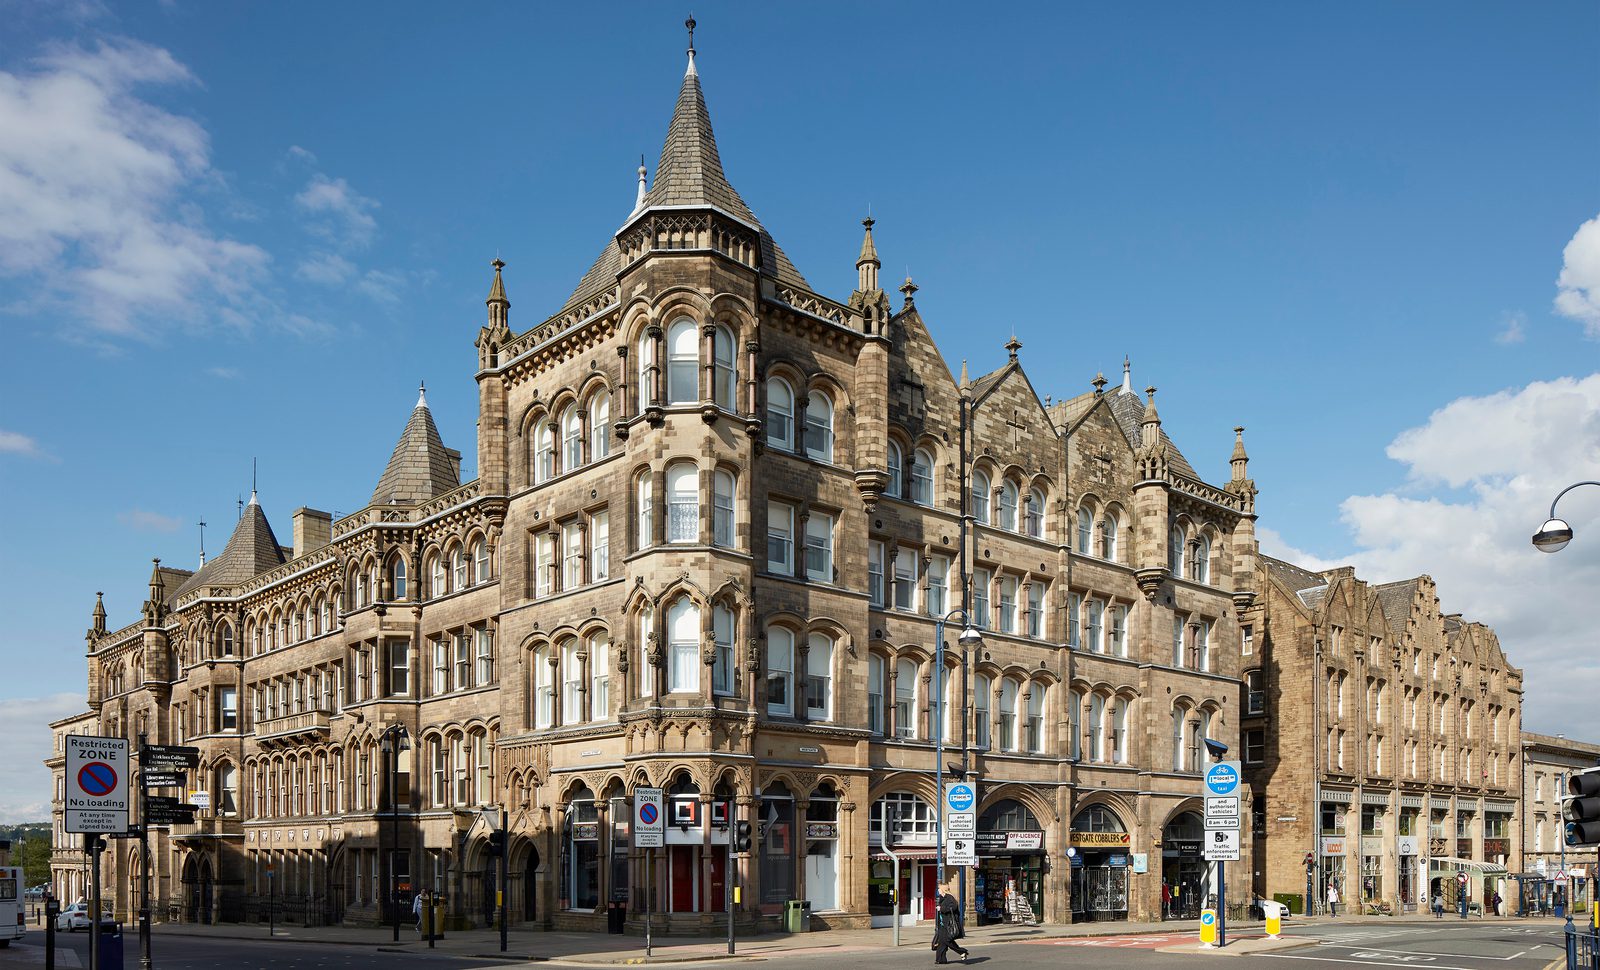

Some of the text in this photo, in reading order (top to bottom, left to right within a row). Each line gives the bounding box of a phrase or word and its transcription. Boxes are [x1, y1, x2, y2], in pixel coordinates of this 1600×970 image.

[71, 739, 124, 750] Restricted
[79, 750, 116, 760] ZONE
[87, 799, 124, 808] loading
[1095, 834, 1120, 842] COBBLERS
